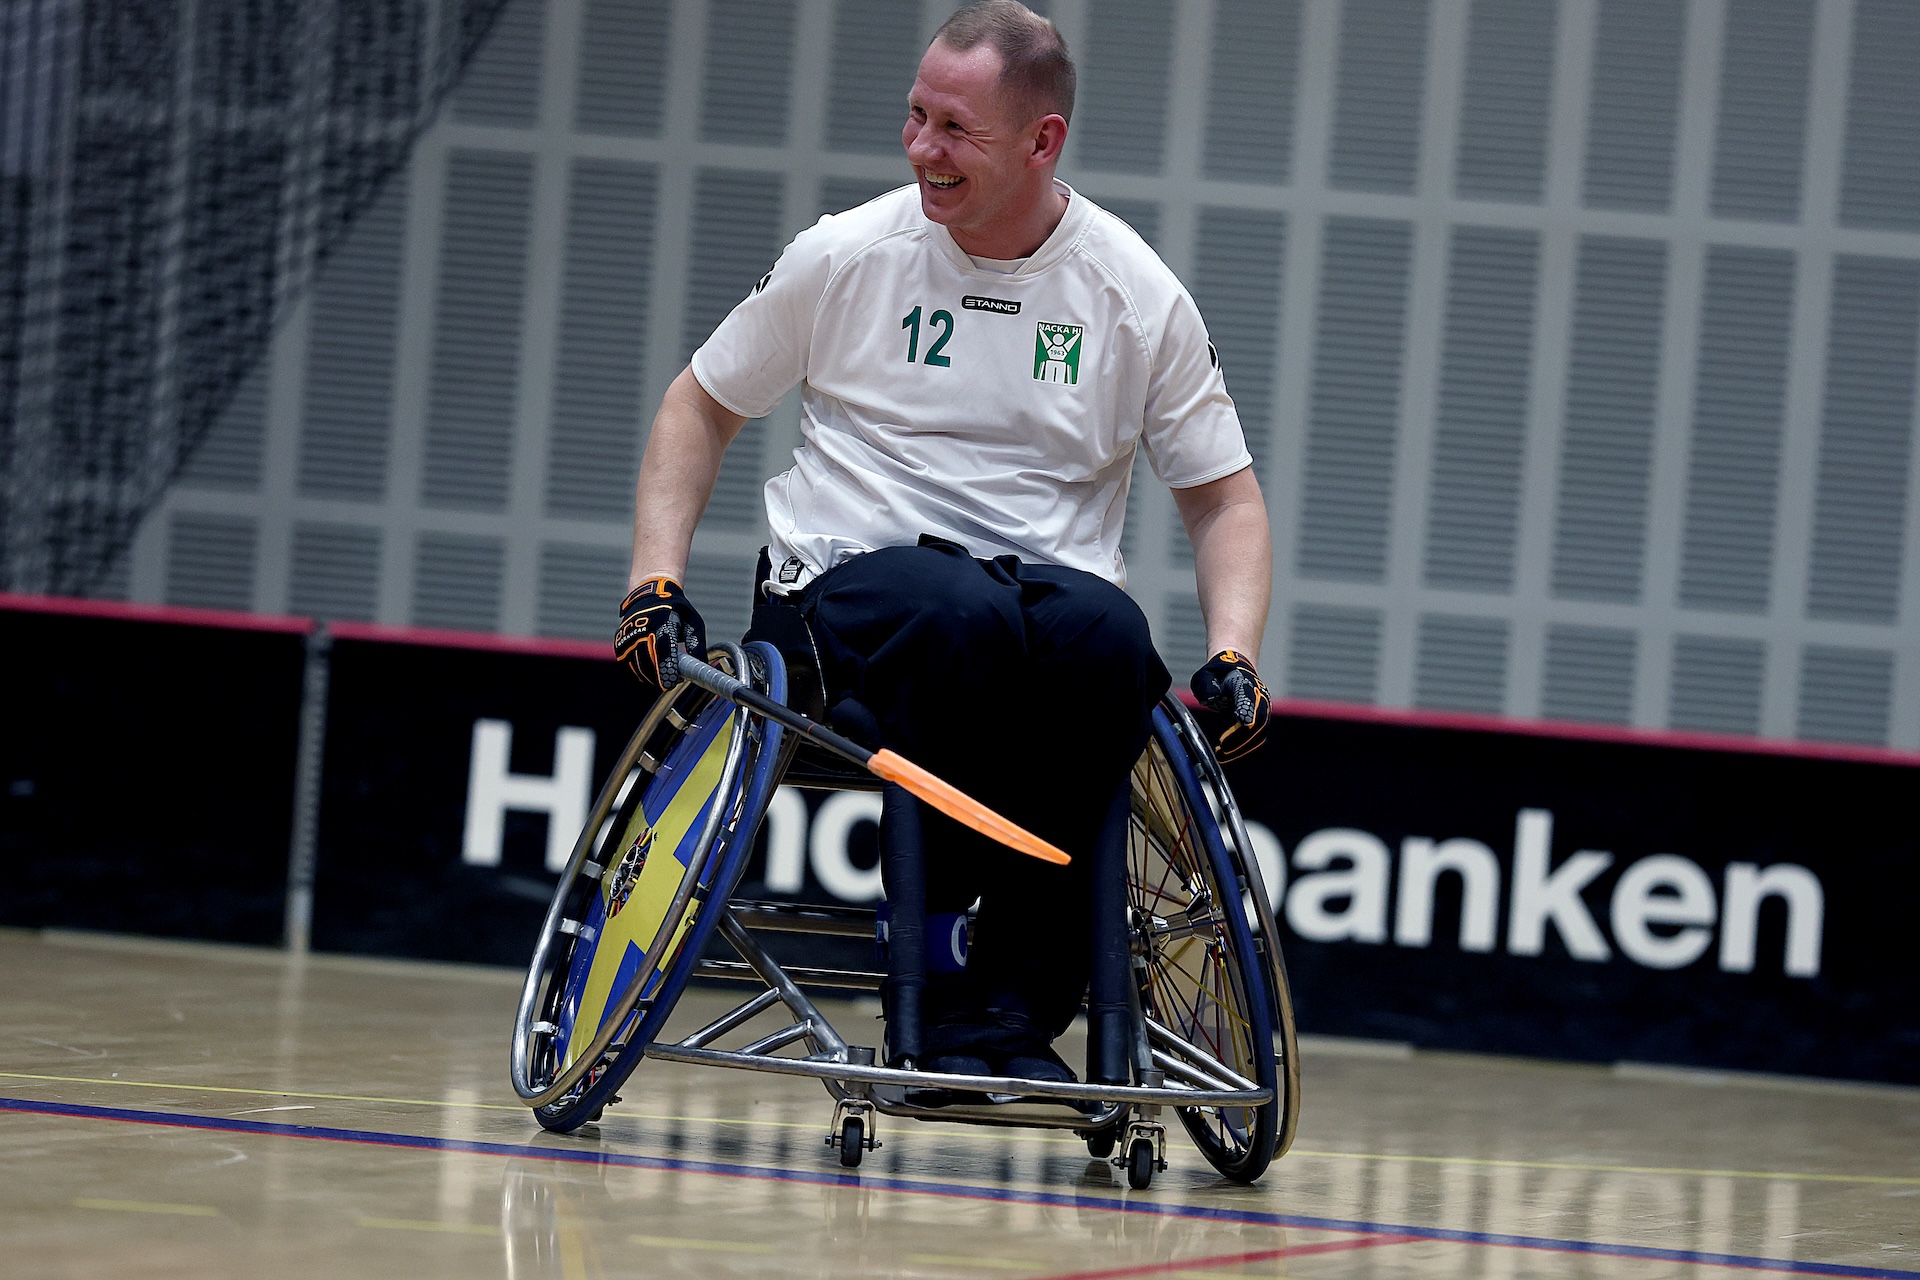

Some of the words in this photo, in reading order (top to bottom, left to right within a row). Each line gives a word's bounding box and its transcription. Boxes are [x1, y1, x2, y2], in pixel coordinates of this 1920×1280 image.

[964, 298, 1018, 312] STANNO
[1038, 323, 1070, 334] NACKA
[901, 305, 954, 368] 12
[1050, 349, 1065, 357] 1963
